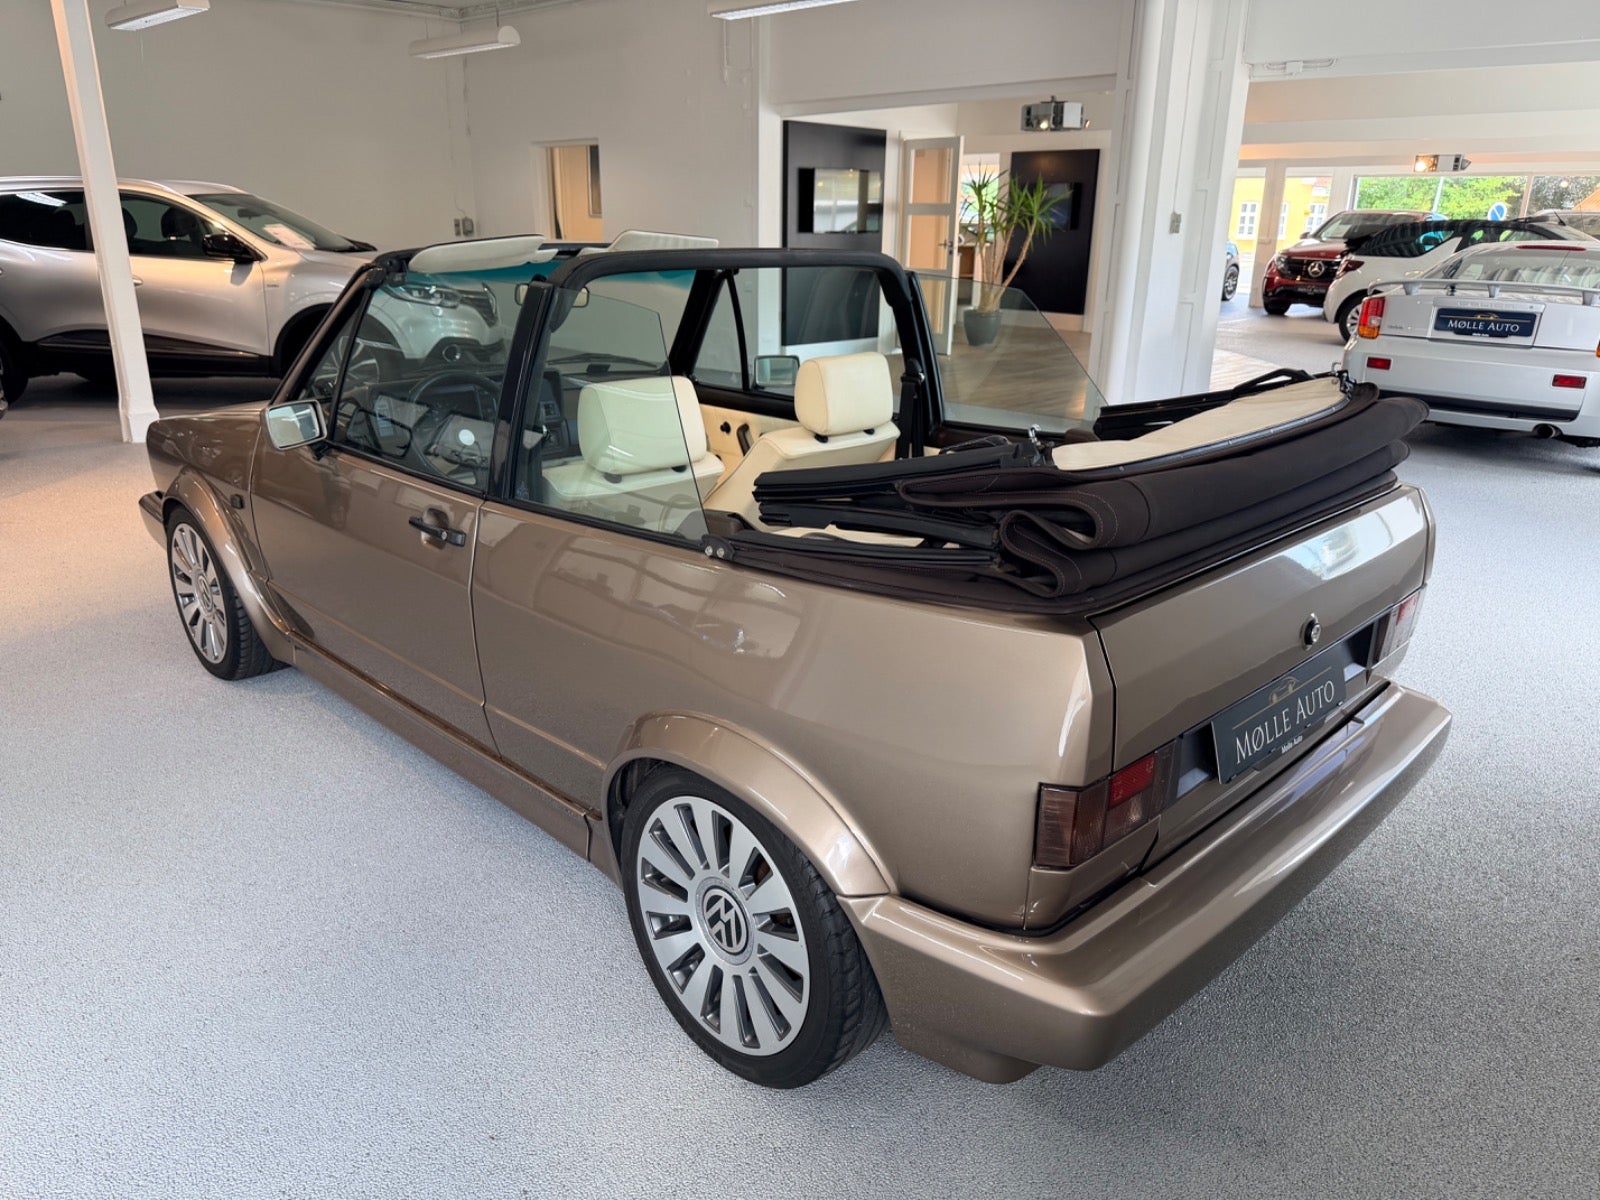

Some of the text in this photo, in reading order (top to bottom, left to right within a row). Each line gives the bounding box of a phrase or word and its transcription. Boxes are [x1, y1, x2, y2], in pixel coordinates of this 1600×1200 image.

[1448, 319, 1520, 332] MØLLE AUTO
[1235, 680, 1335, 765] MØLLE AUTO
